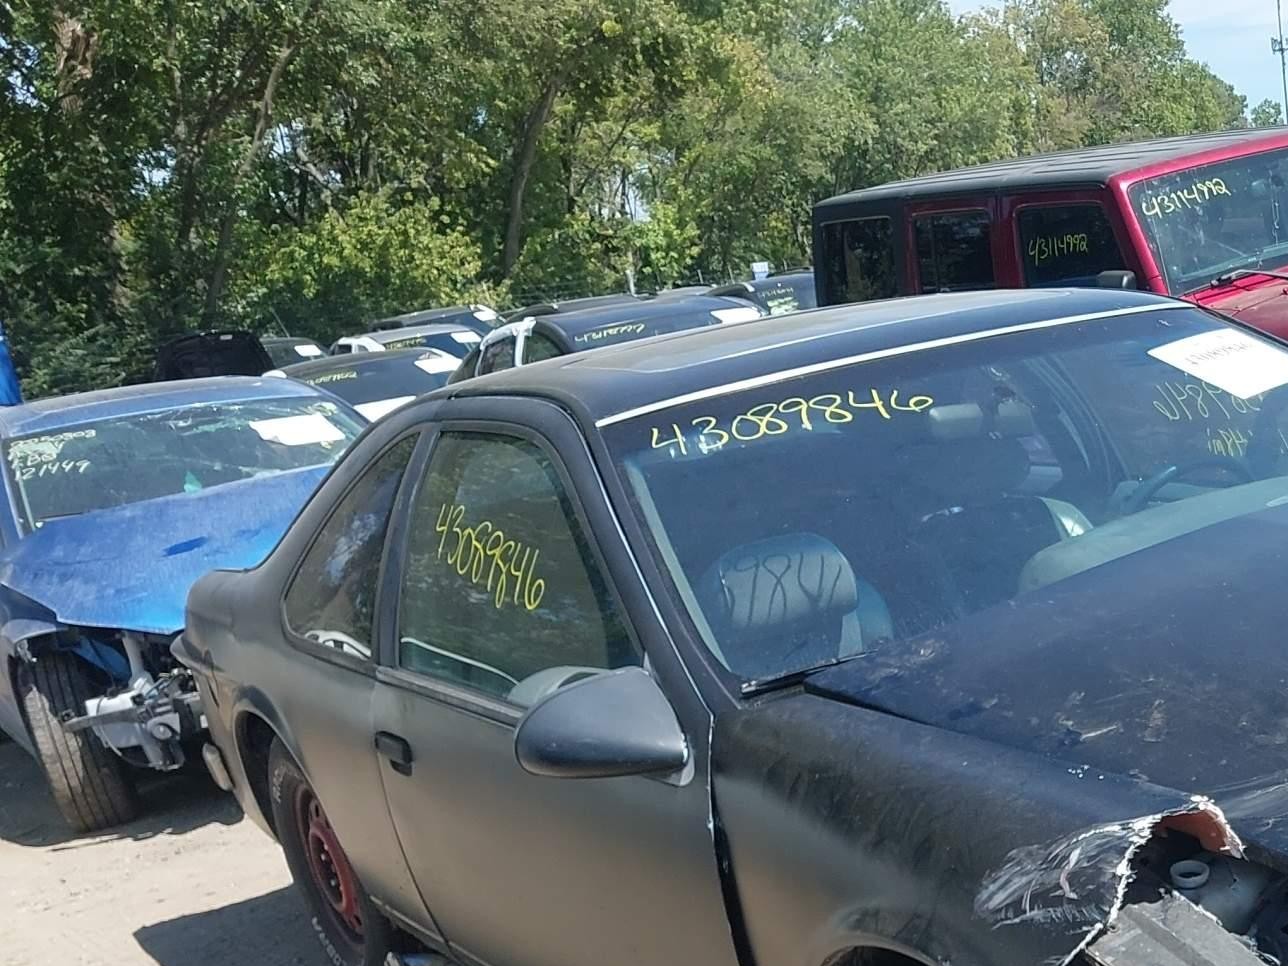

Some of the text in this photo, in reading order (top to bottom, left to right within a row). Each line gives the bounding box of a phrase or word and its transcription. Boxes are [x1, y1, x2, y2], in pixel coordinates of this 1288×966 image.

[1142, 178, 1232, 219] 43114992
[1028, 233, 1088, 267] 43114992
[651, 388, 933, 456] 43089846
[435, 503, 545, 610] 43089846
